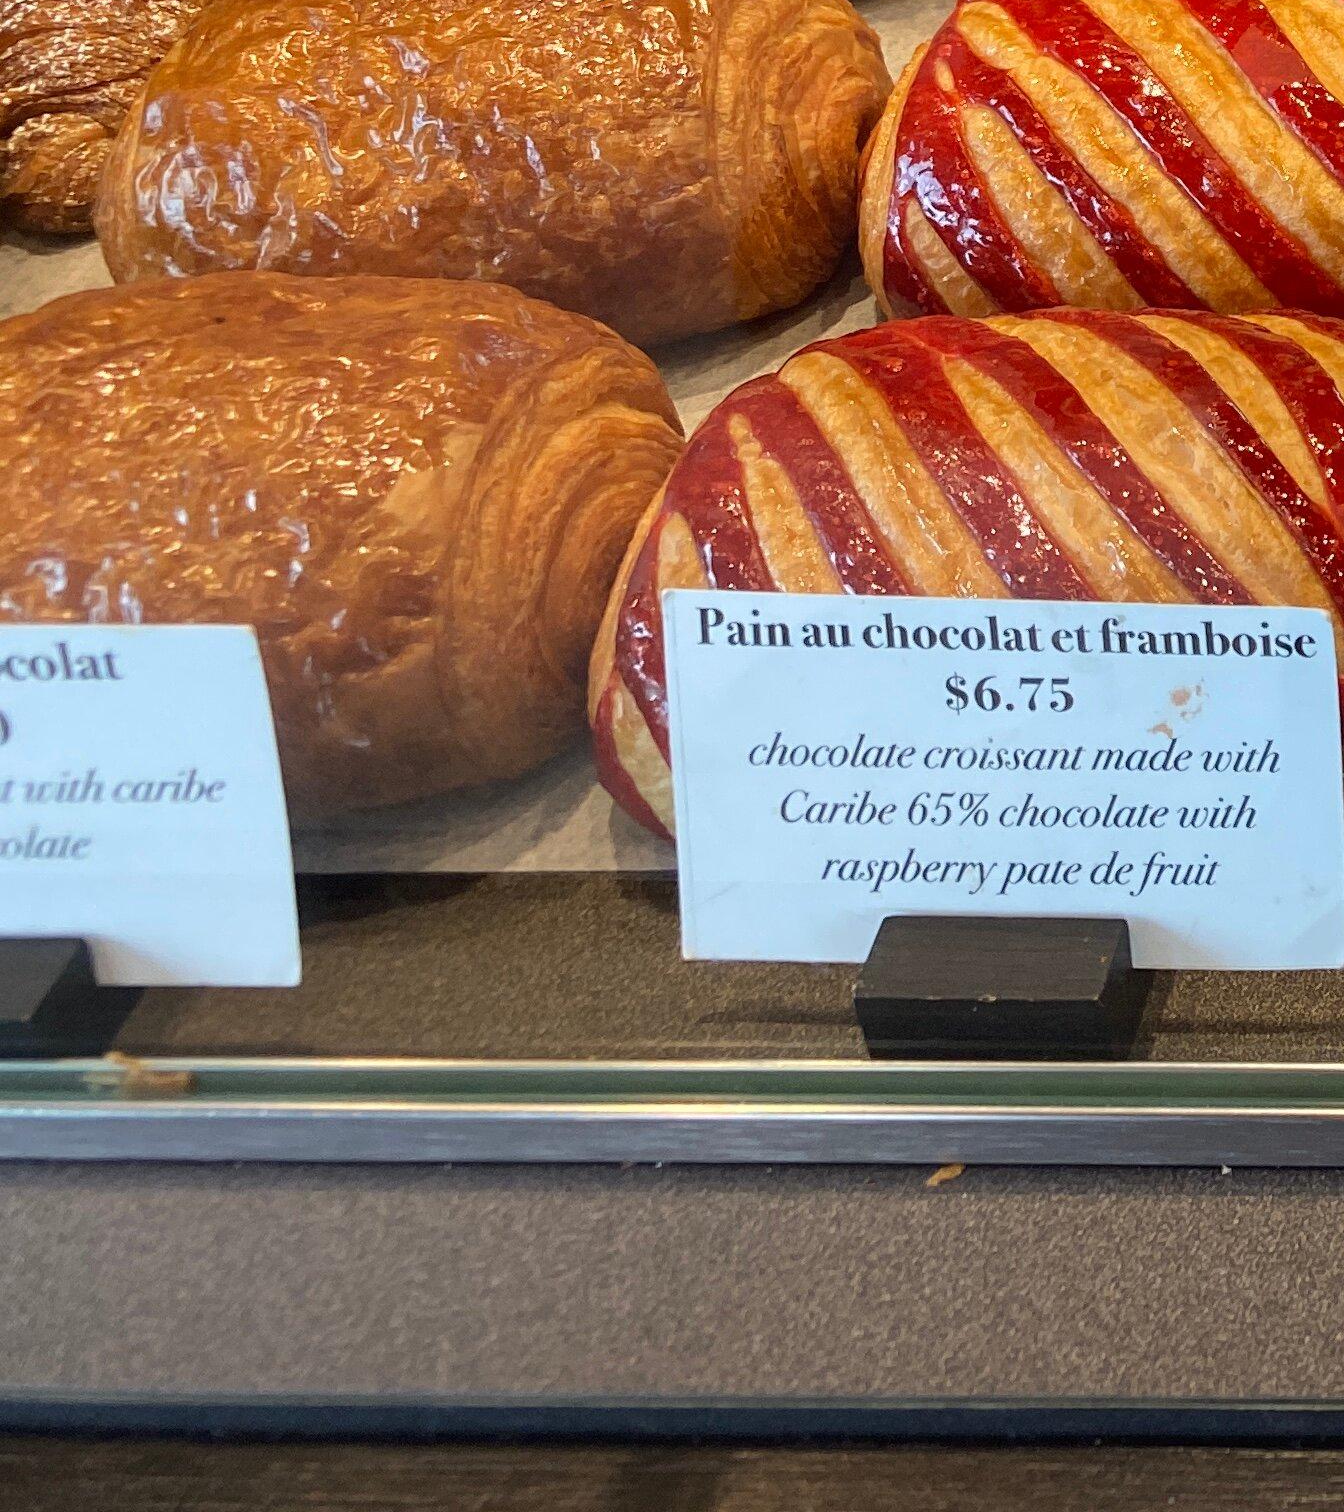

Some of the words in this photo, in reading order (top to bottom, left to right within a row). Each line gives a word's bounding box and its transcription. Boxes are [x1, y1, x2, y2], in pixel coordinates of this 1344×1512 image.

[696, 606, 793, 648] Pain
[802, 621, 853, 648] au
[862, 614, 1042, 653] chocolat
[1051, 624, 1092, 654] et
[1100, 617, 1317, 658] framboise
[0, 641, 123, 680] colat
[944, 672, 1074, 715] $6.75
[748, 732, 914, 771] chocolate
[923, 738, 1084, 771] croissant
[1091, 737, 1191, 773] made
[1201, 740, 1281, 774] with
[23, 767, 104, 803] with
[112, 767, 226, 804] caribe
[780, 790, 896, 826] Caribe
[907, 792, 990, 827] 65%
[999, 792, 1167, 829] chocolate
[1177, 795, 1257, 830] with
[821, 849, 995, 893] raspberry
[999, 854, 1082, 894] pate
[1090, 850, 1133, 887] de
[1130, 853, 1219, 896] fruit
